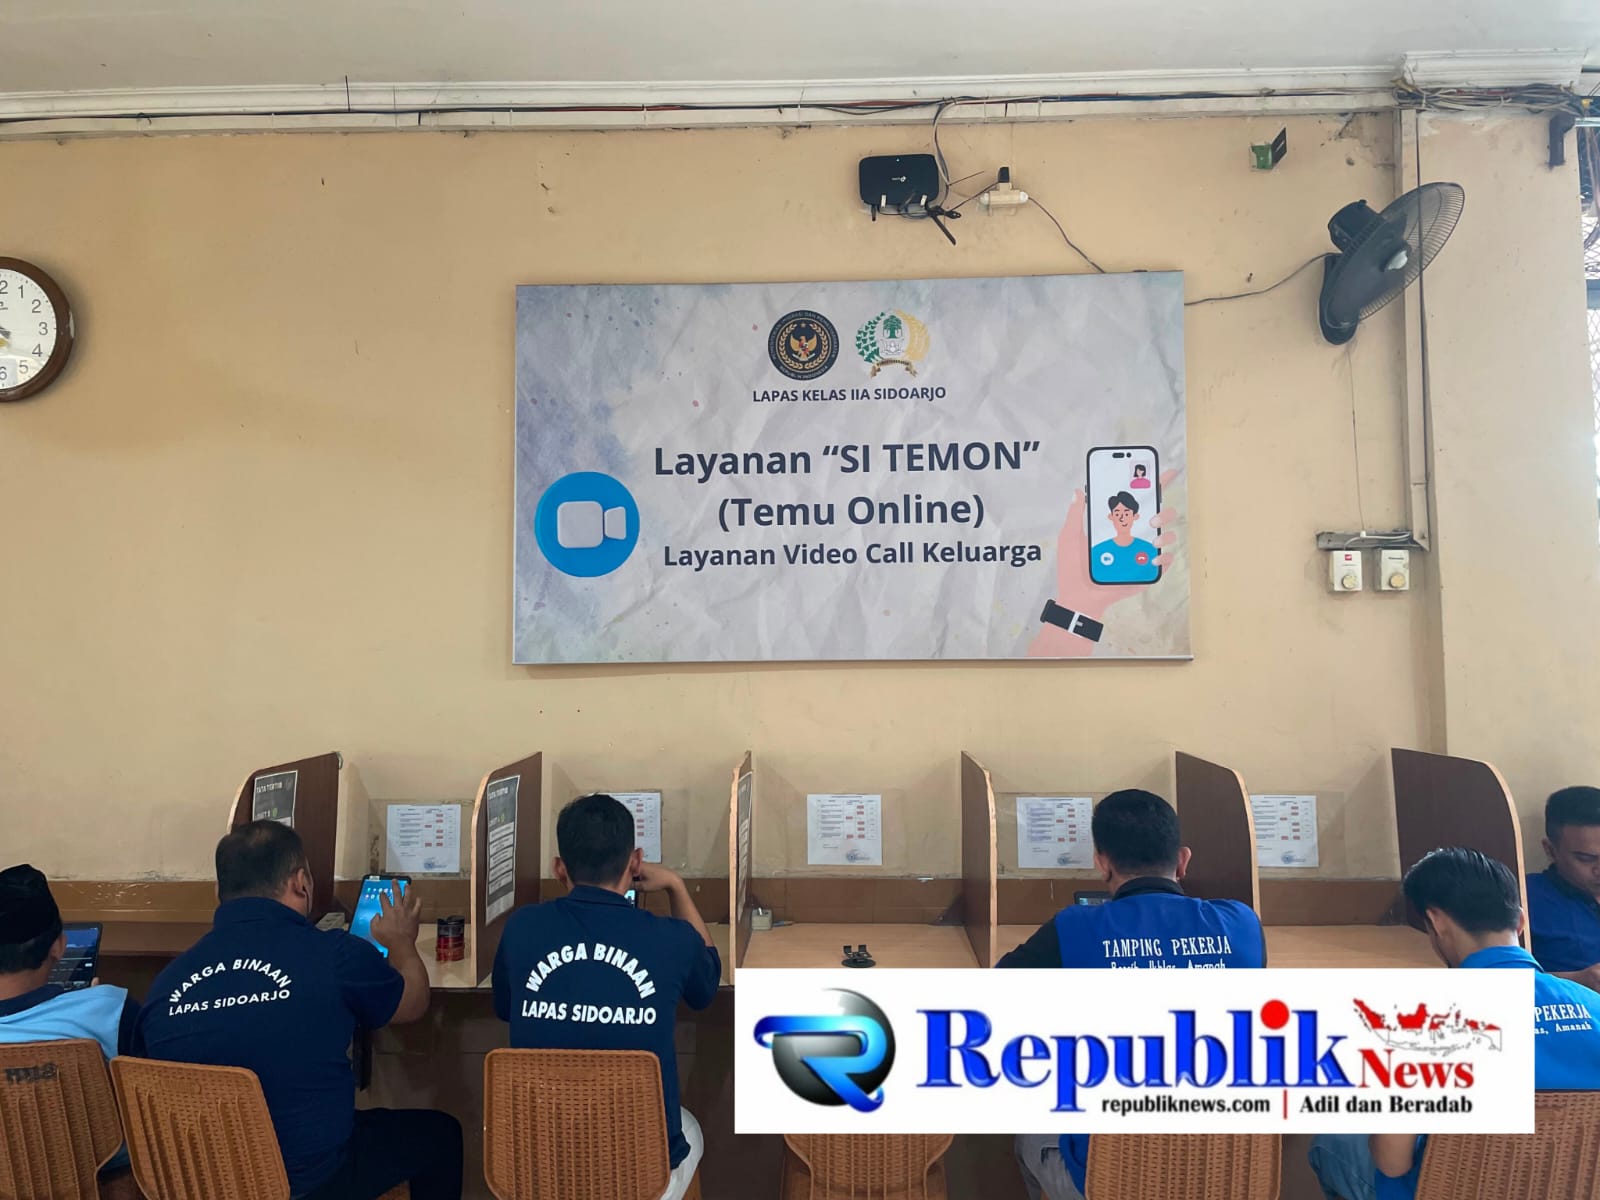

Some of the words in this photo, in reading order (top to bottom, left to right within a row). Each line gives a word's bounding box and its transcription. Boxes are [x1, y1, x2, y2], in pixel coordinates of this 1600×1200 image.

[18, 285, 24, 299] 1
[32, 299, 41, 313] 2
[38, 322, 48, 336] 3
[32, 344, 43, 357] 4
[19, 360, 29, 375] 5
[753, 390, 799, 402] LAPAS
[802, 389, 847, 401] KELAS
[851, 388, 871, 400] IIA
[874, 386, 946, 402] SIDOARJO
[655, 447, 811, 484] Layanan
[882, 441, 1040, 472] TEMON”
[718, 498, 835, 532] (Temu
[848, 494, 984, 528] Online)
[664, 546, 775, 572] Layanan
[783, 543, 857, 564] Video
[866, 542, 913, 563] Call
[923, 541, 1041, 567] Keluarga
[1102, 938, 1163, 957] TAMPING
[1170, 935, 1232, 956] PEKERJA
[525, 942, 588, 992] WARGA
[593, 943, 656, 999] BINAAN
[169, 962, 226, 1003] WARGA
[232, 959, 292, 988] BINAAN
[169, 1001, 209, 1016] LAPAS
[213, 989, 290, 1009] SIDOARJO
[521, 1000, 567, 1020] LAPAS
[571, 1004, 656, 1025] SIDOARJO
[1535, 1003, 1593, 1022] PEKERJA
[1556, 1021, 1593, 1032] Amanah
